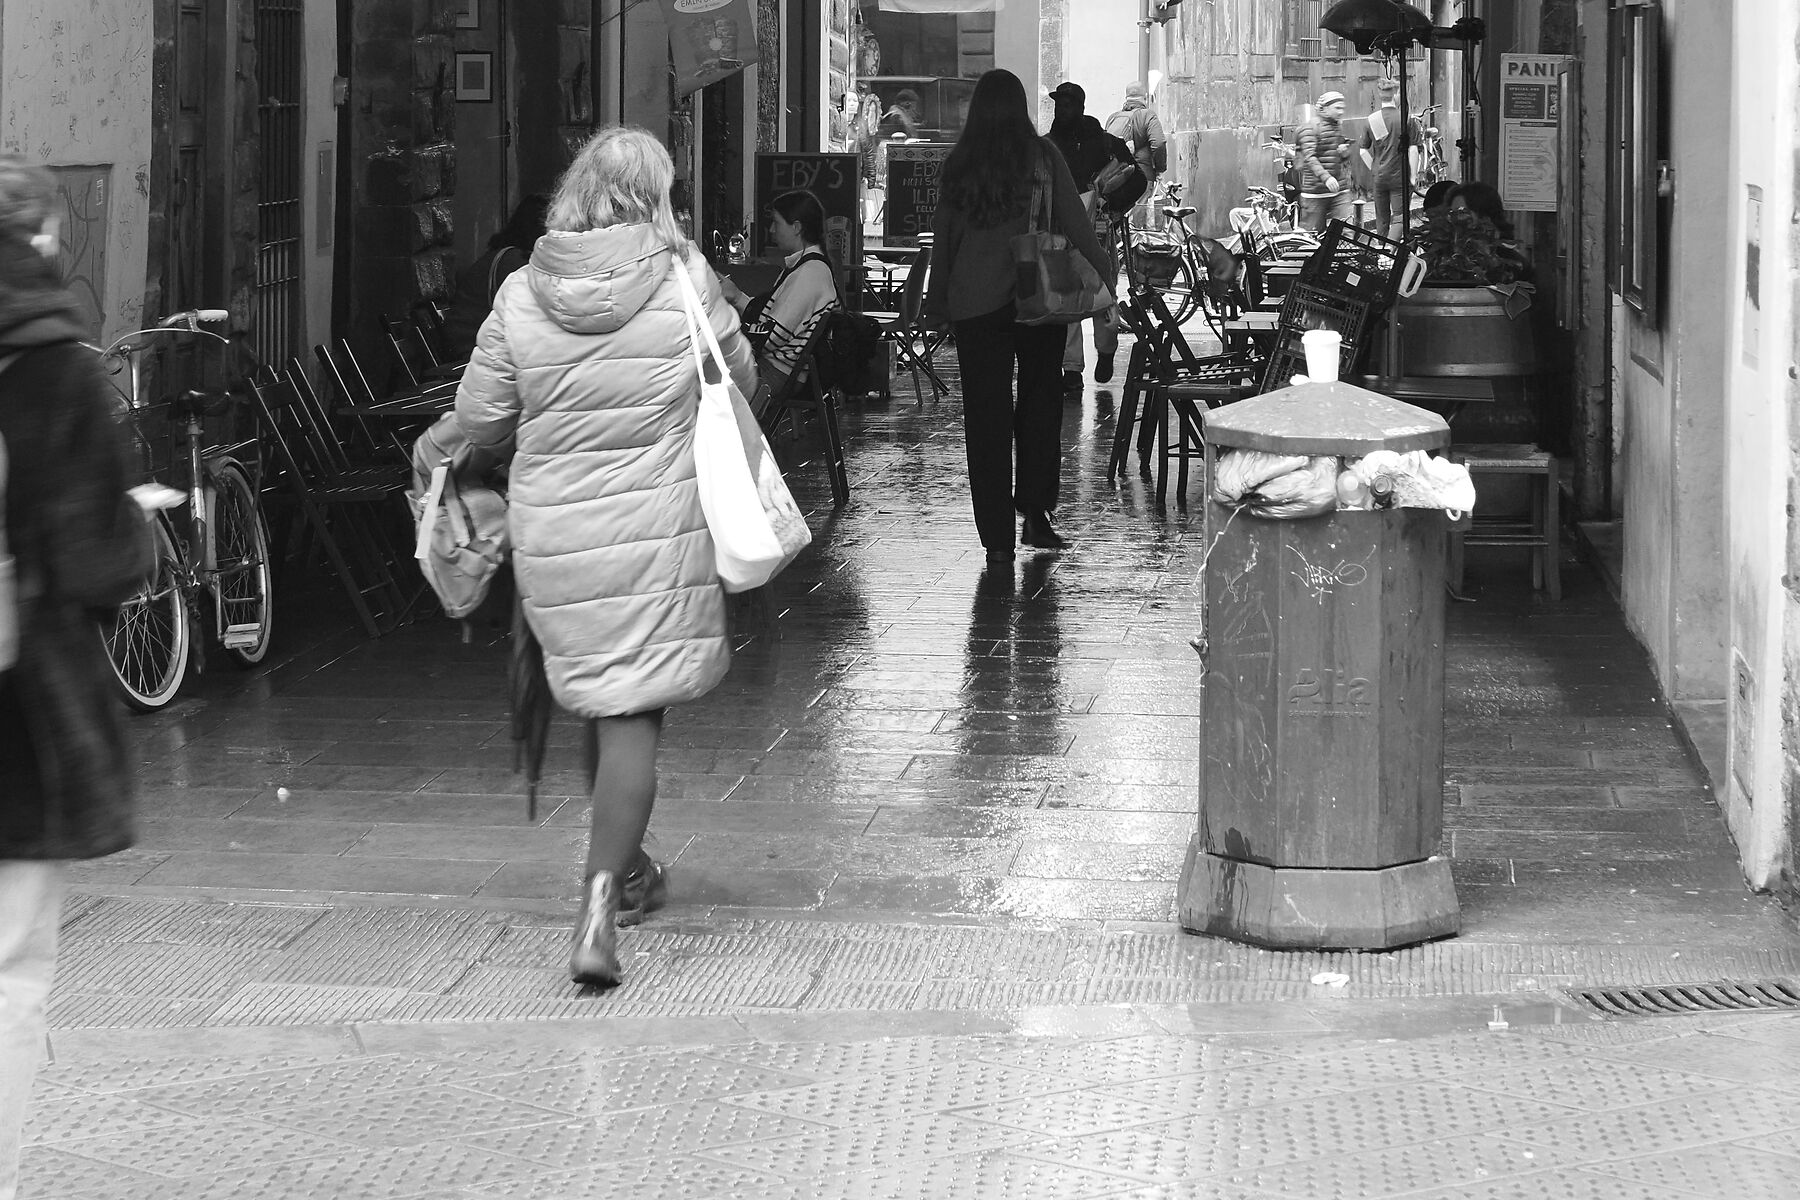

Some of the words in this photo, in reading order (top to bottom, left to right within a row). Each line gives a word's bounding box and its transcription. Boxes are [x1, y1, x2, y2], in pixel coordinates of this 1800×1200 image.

[1508, 62, 1555, 77] PANI
[772, 158, 844, 191] EBY'S
[913, 161, 940, 177] EBY
